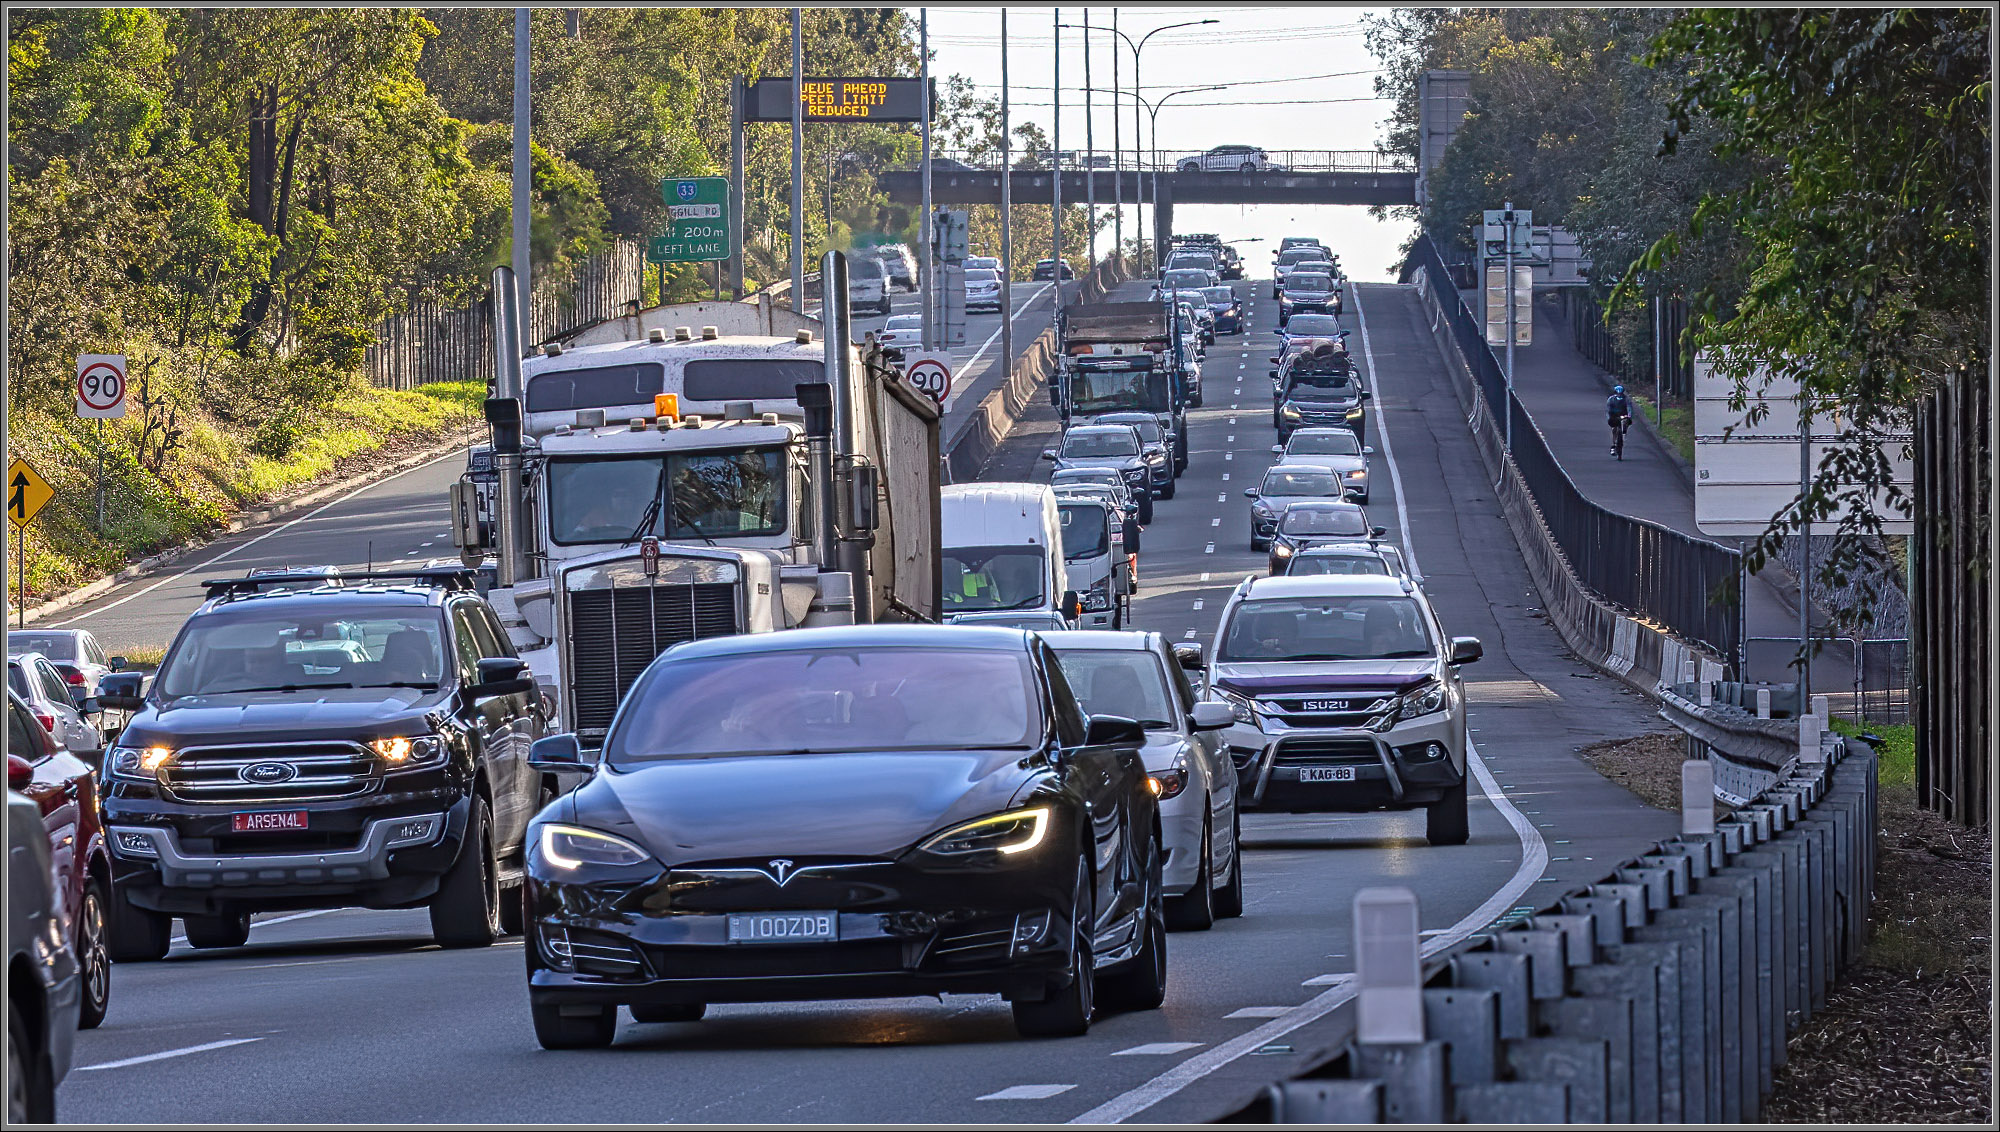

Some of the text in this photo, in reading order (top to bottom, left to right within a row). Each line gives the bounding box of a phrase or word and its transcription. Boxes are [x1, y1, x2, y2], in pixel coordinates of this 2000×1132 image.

[801, 83, 887, 94] UEUE AHEAD
[801, 94, 887, 105] PEED LIMIT
[808, 105, 869, 117] REDUCED
[680, 185, 695, 196] 33
[704, 207, 718, 216] RD
[657, 243, 721, 255] LEFT LANE
[85, 375, 118, 398] 90
[911, 371, 944, 393] 90
[1303, 701, 1349, 710] ISUZU
[255, 766, 281, 777] Ford
[247, 813, 302, 829] ARSEN4L
